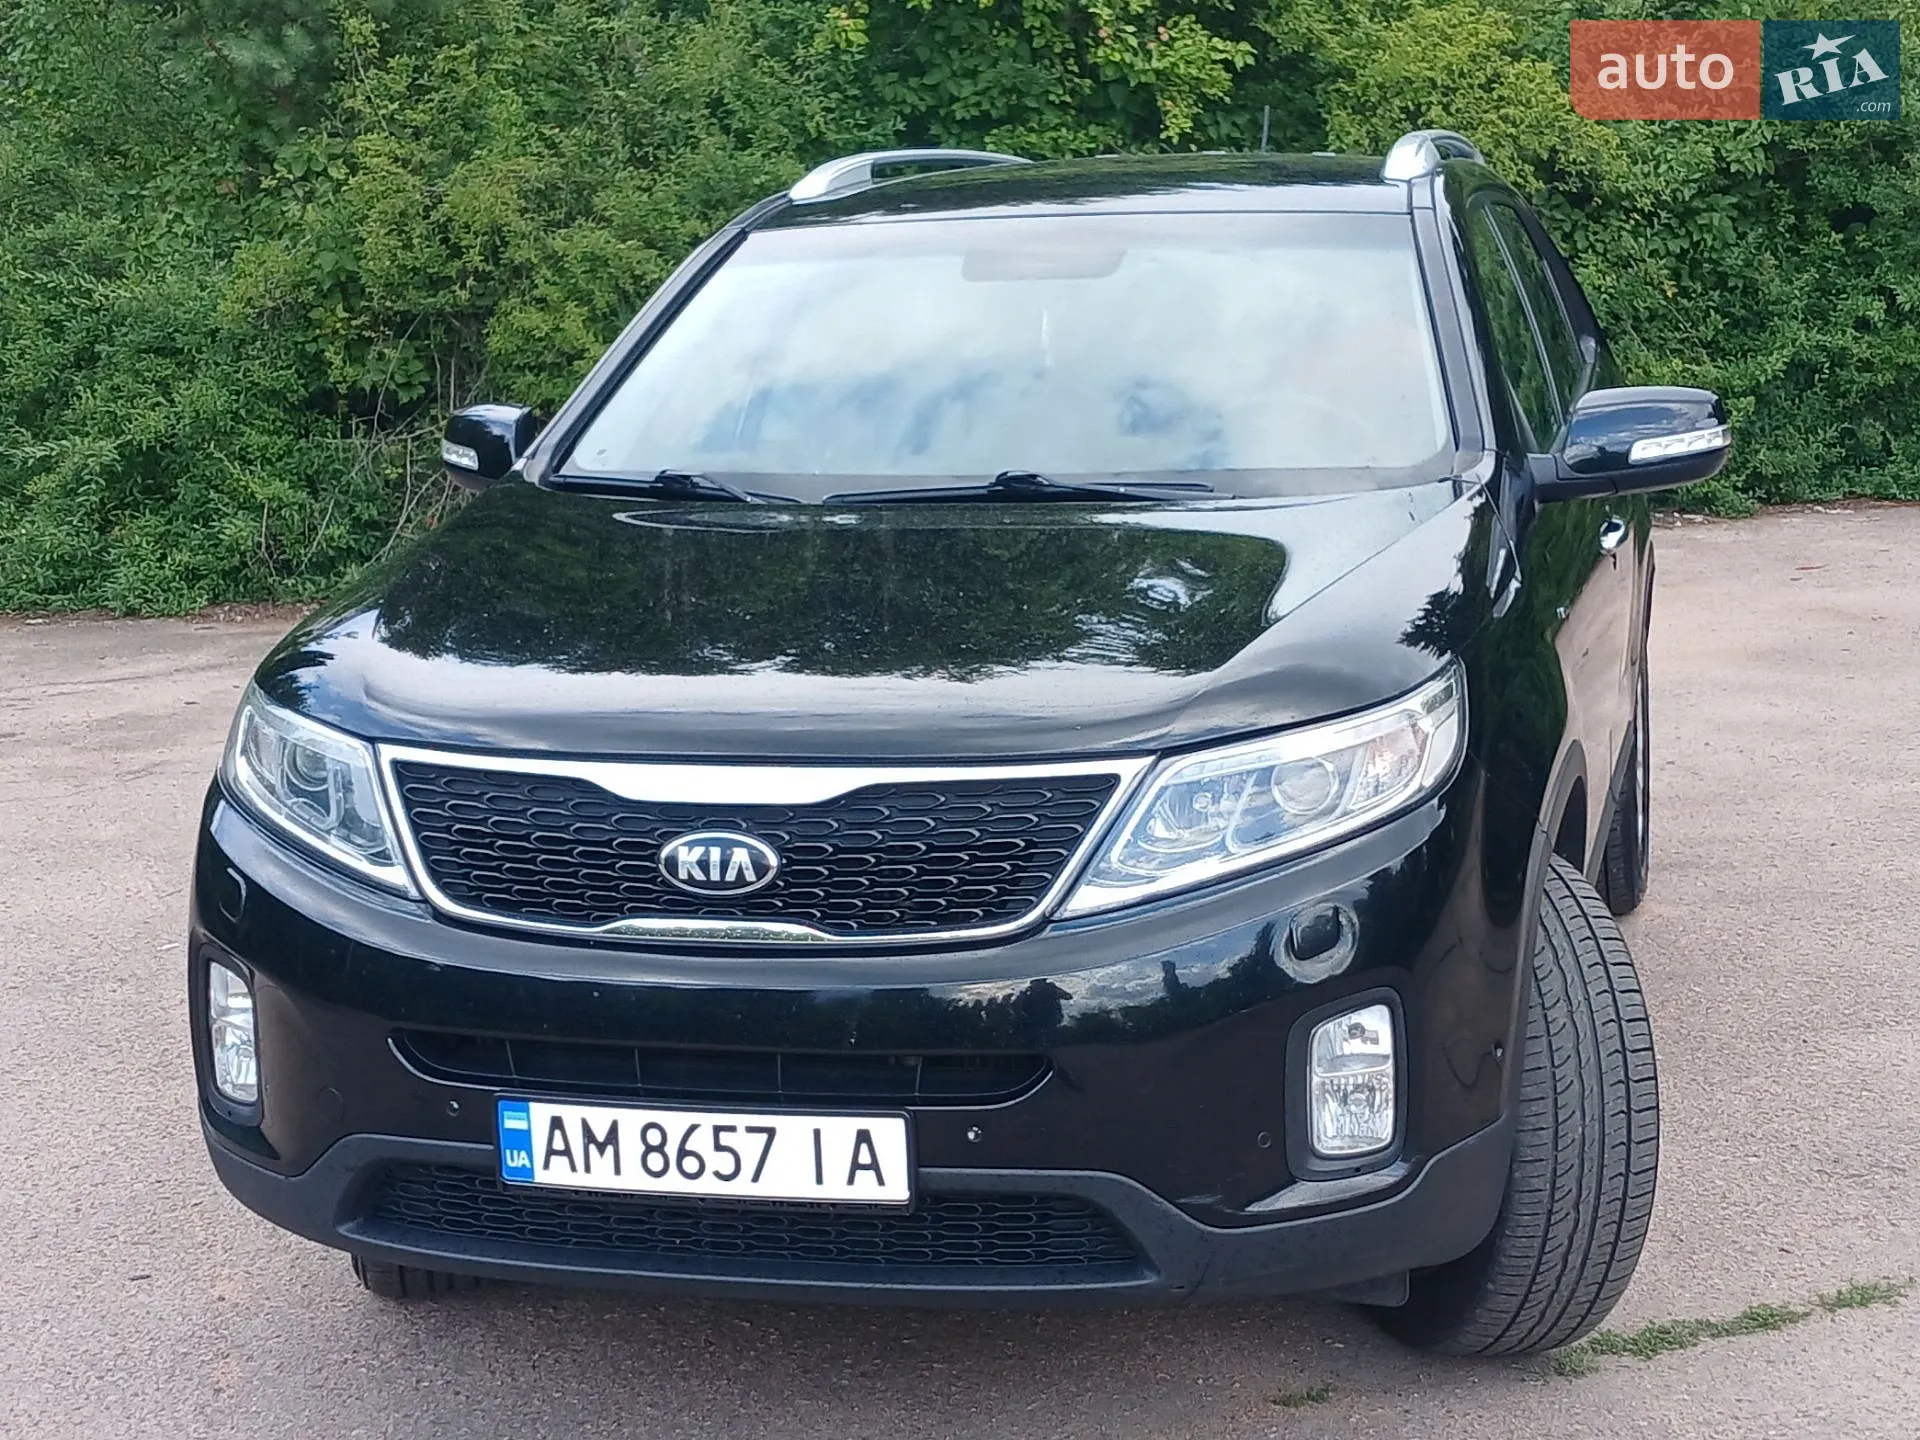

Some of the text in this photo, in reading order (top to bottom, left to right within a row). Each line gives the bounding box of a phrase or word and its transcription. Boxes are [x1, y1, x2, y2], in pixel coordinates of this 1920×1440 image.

[677, 845, 757, 881] KIA
[505, 1149, 531, 1168] UA
[543, 1115, 886, 1186] AM 8657 IA
